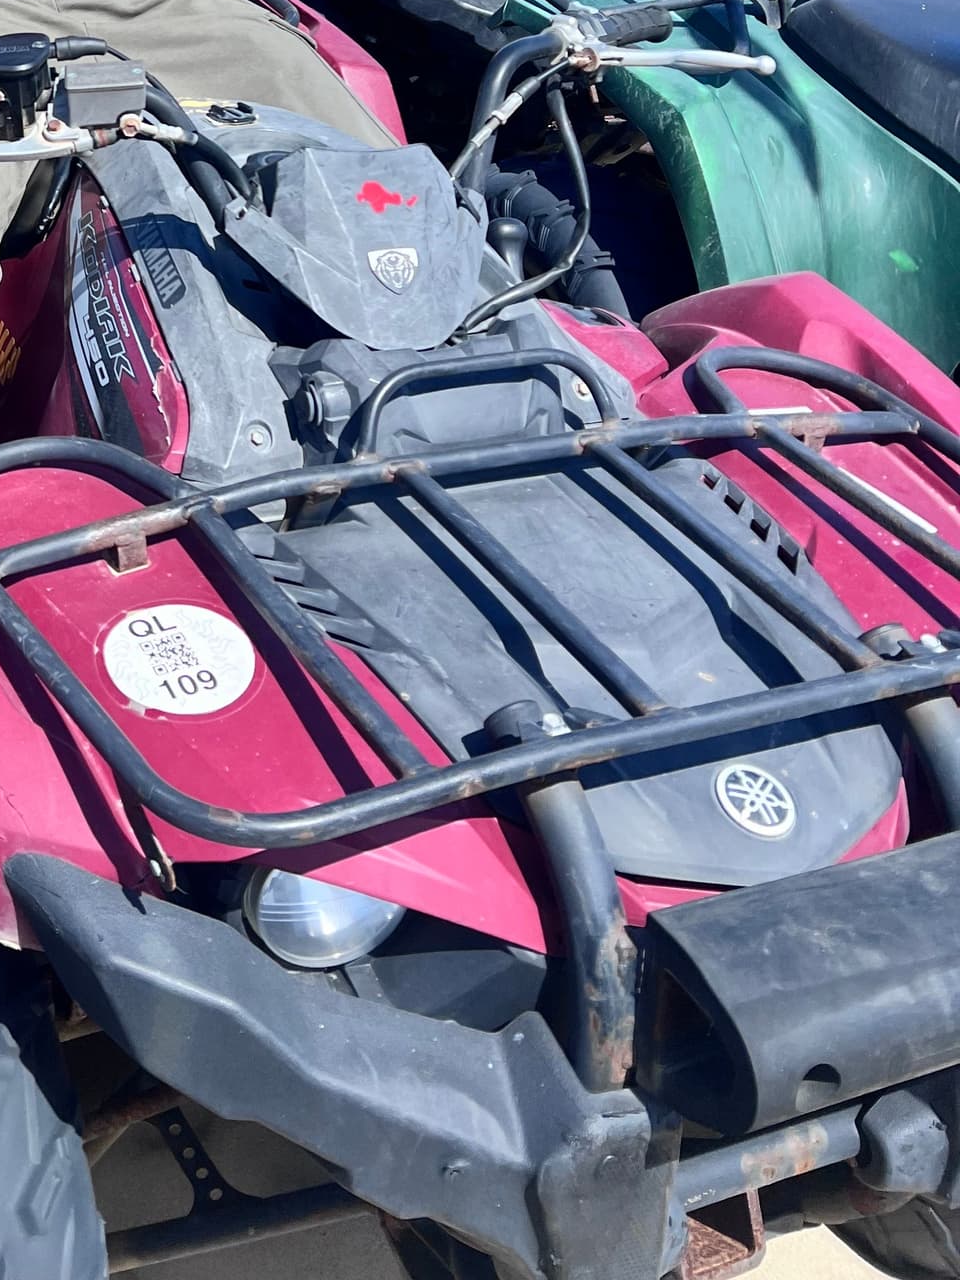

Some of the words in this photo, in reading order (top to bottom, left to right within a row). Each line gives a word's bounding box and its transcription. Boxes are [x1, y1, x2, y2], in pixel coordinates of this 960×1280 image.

[78, 210, 136, 384] KODIAK
[137, 222, 183, 303] YAMAHA
[84, 315, 110, 387] 450
[128, 615, 177, 638] QL
[158, 669, 218, 700] 109
